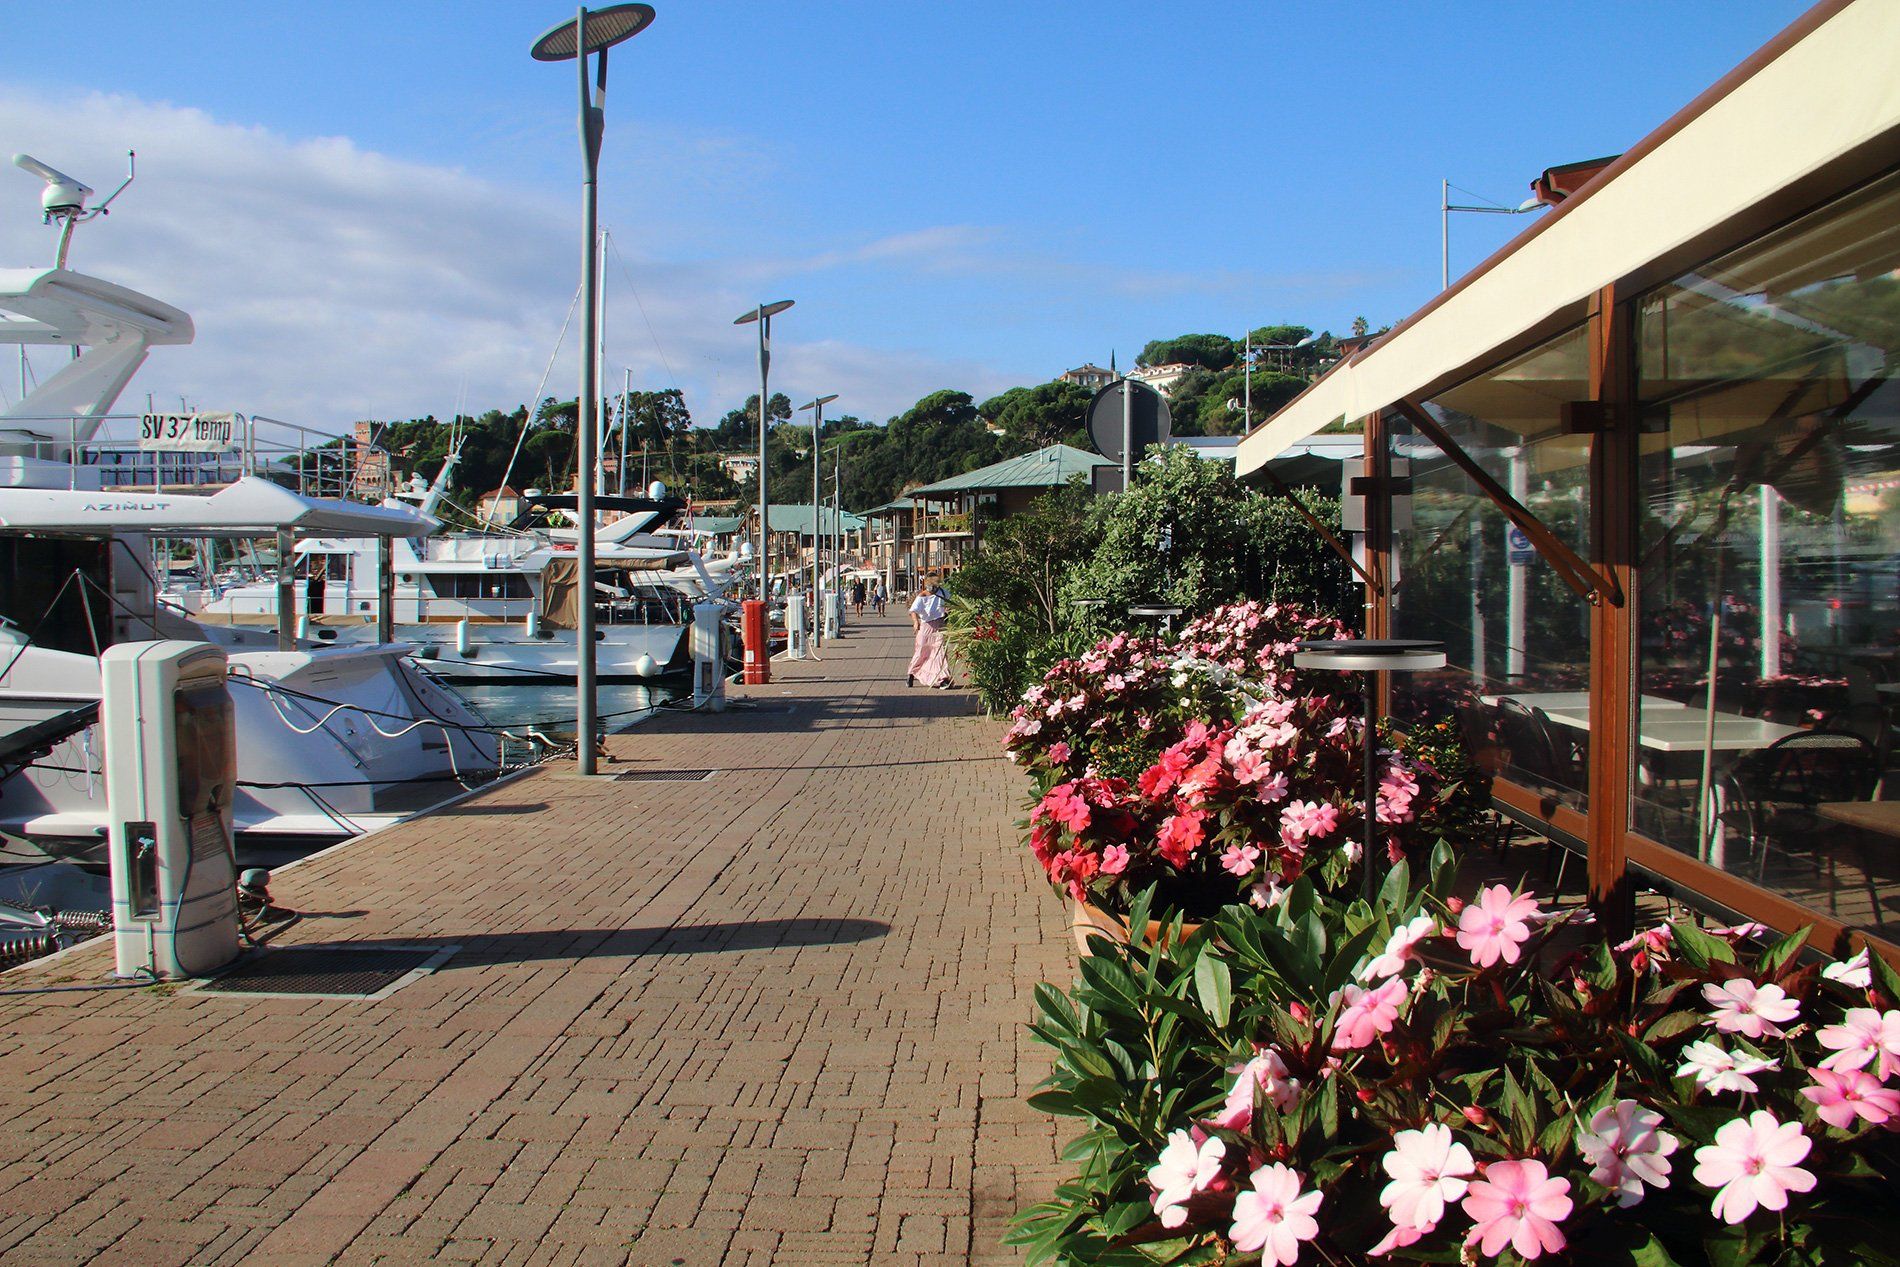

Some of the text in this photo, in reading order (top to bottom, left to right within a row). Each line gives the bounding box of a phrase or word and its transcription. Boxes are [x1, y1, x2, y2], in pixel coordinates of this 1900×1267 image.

[143, 414, 231, 445] SV 37 temp
[82, 503, 170, 511] AZIMUT
